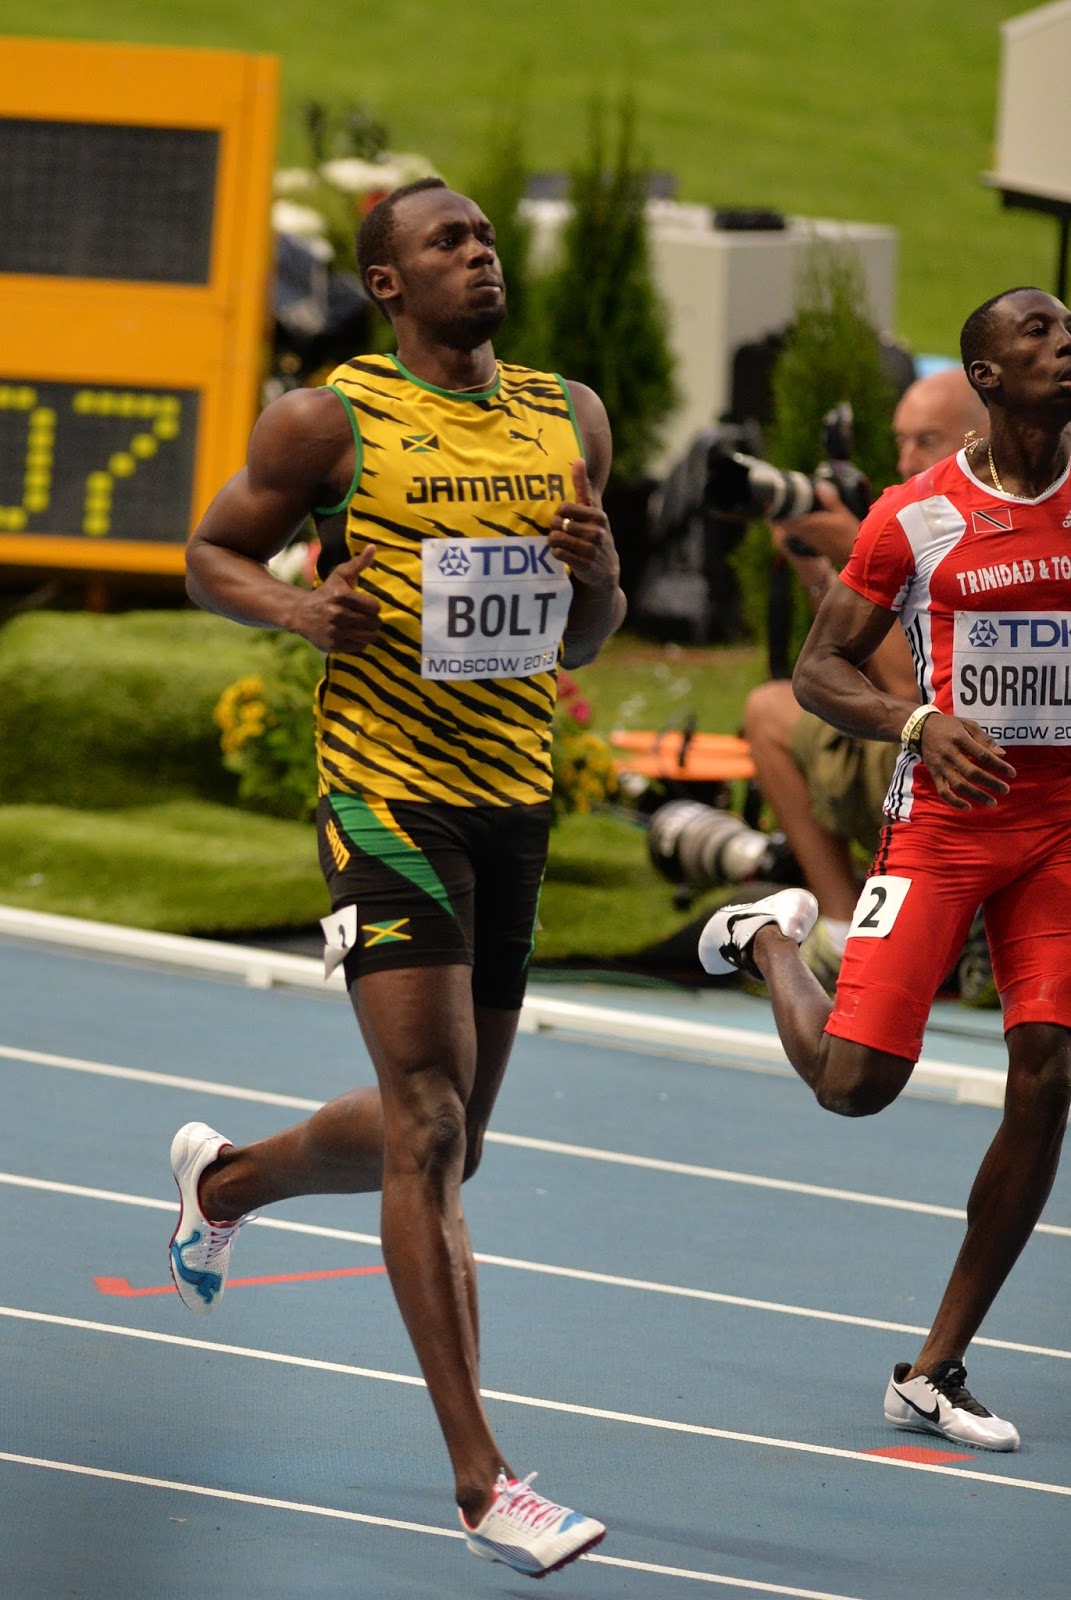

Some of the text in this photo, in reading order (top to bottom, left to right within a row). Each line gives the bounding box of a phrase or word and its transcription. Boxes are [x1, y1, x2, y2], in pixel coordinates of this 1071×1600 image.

[406, 473, 566, 504] JAMAICA
[470, 544, 555, 576] TDK
[956, 560, 1035, 596] TRINIDAD
[1039, 559, 1050, 580] &
[447, 592, 557, 638] BOLT
[428, 657, 520, 673] MOSCOW
[857, 886, 887, 928] 2
